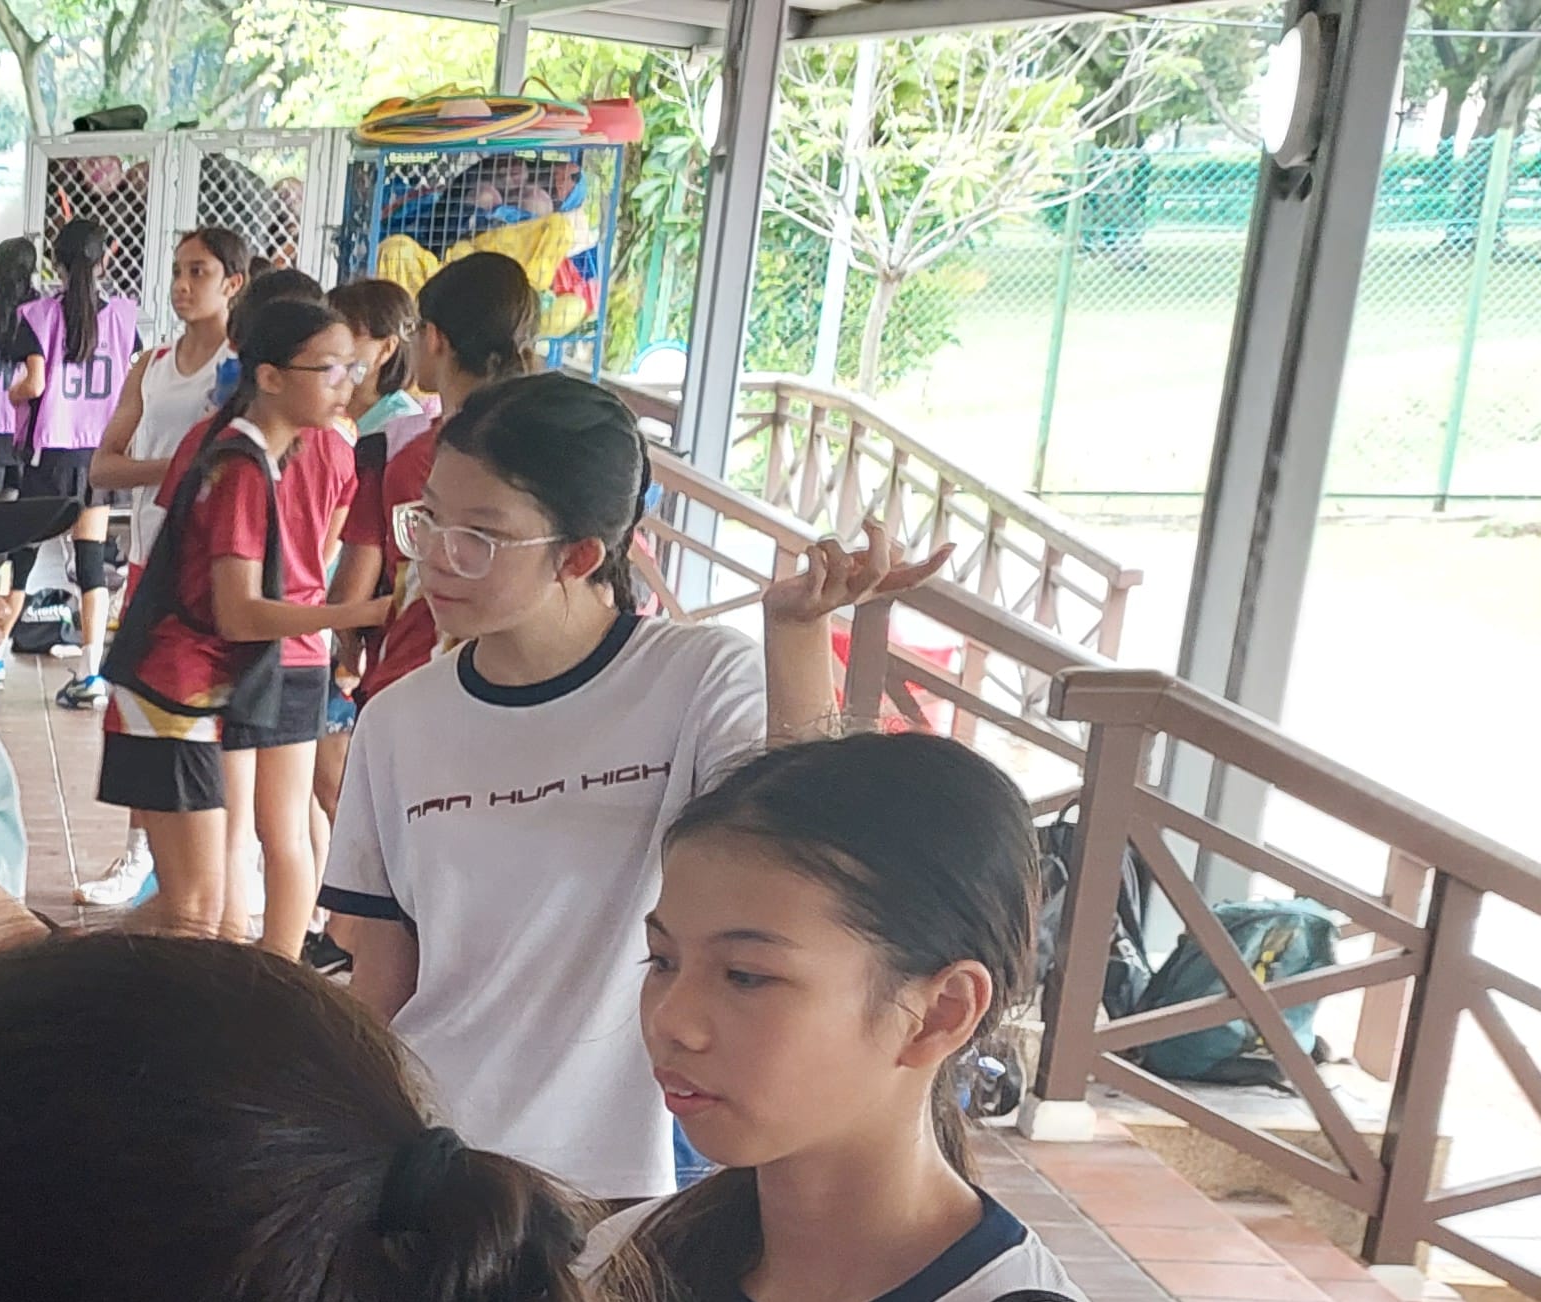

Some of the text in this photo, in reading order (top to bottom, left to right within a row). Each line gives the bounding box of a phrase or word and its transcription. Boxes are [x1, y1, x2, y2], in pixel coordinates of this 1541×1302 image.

[62, 354, 112, 400] GD
[489, 779, 566, 807] HUA
[580, 761, 672, 791] HIGH
